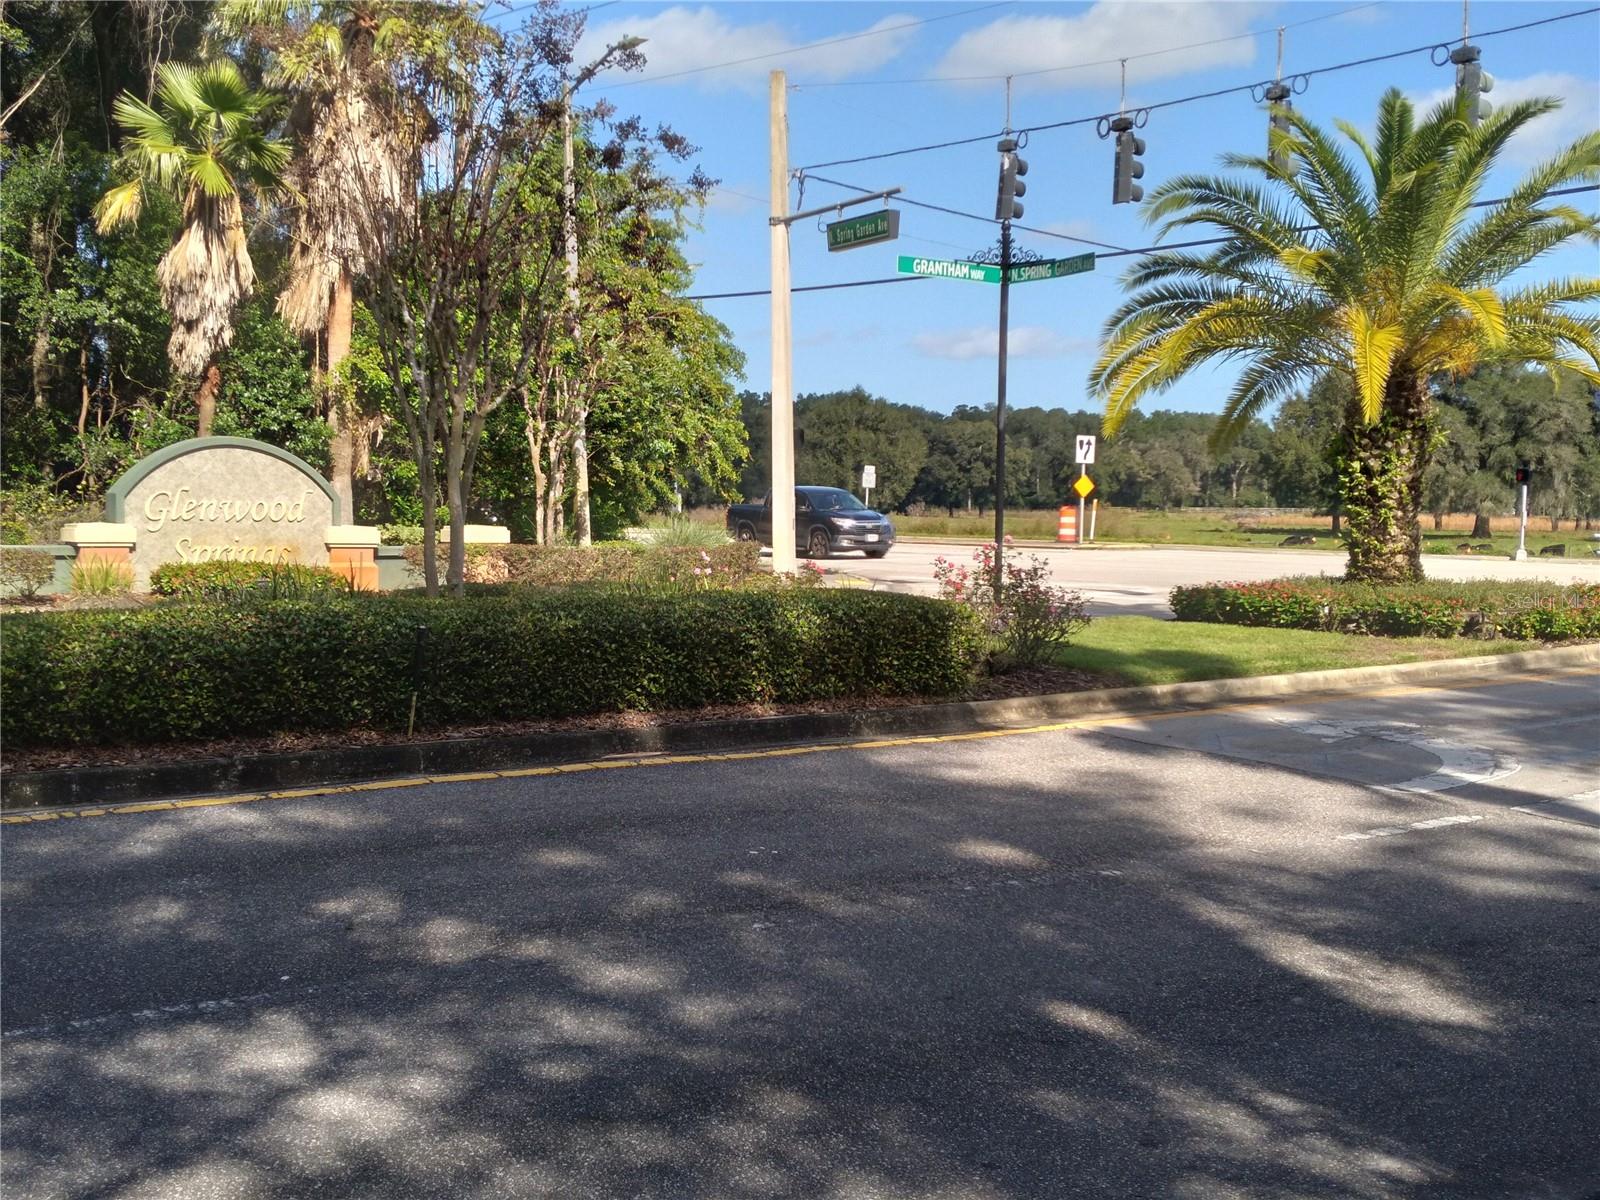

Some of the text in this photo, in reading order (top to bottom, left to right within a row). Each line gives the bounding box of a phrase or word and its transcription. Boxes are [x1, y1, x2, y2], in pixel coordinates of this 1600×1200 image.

[912, 259, 986, 281] GRANTHAM WAY
[144, 486, 314, 533] Glenwood
